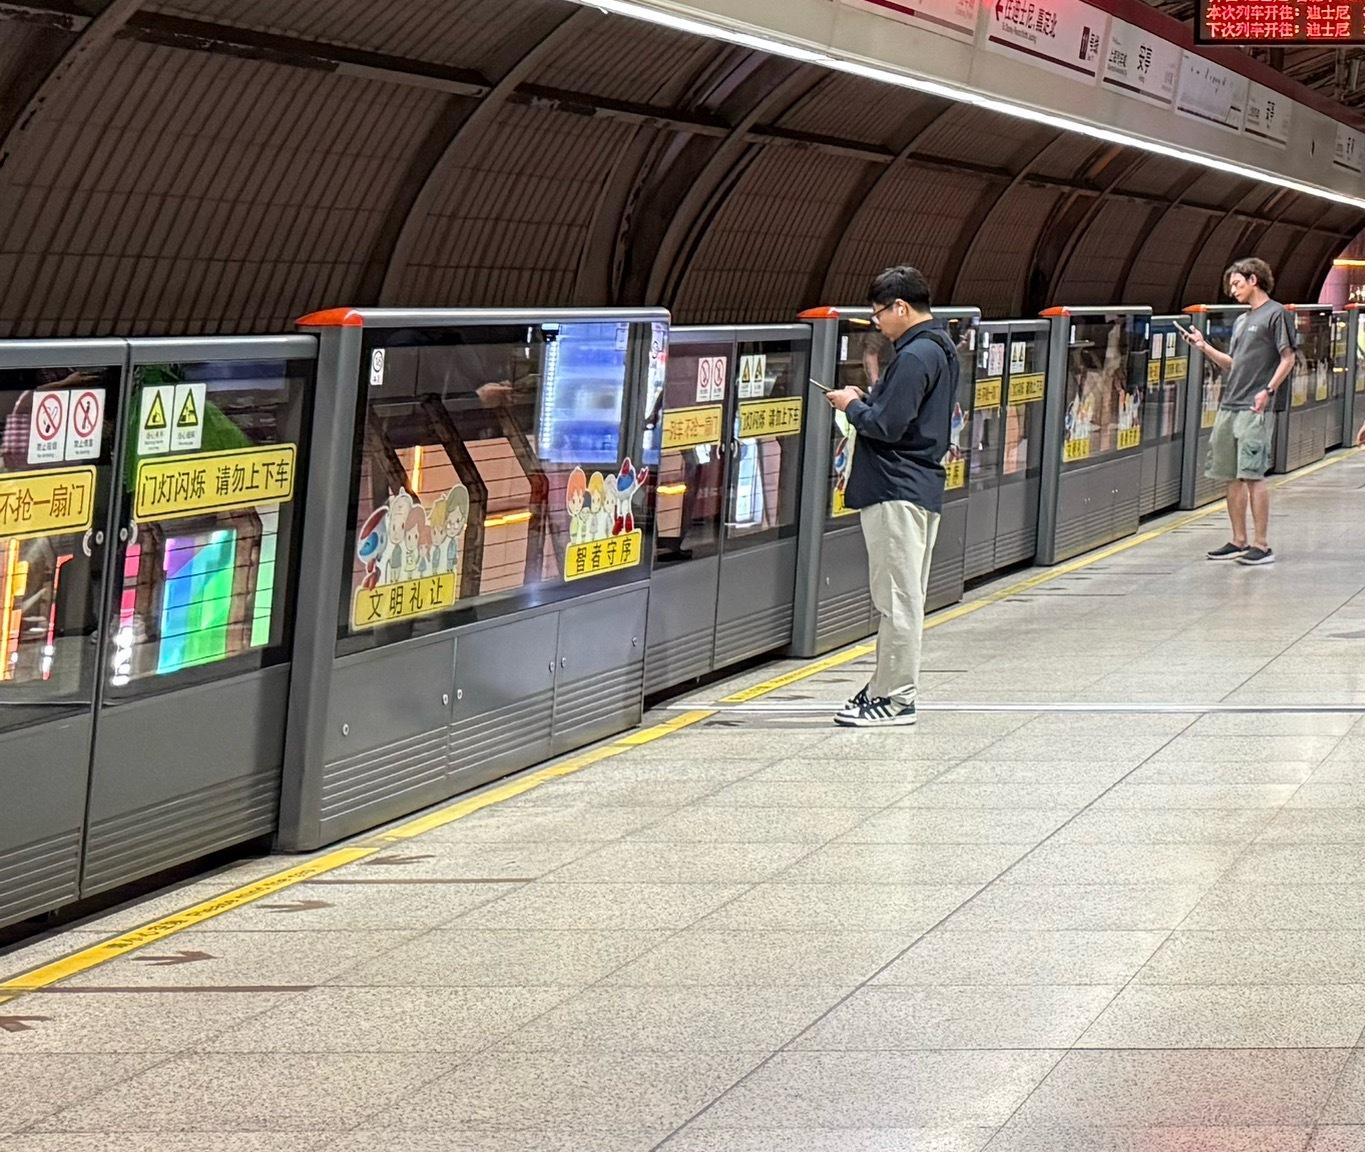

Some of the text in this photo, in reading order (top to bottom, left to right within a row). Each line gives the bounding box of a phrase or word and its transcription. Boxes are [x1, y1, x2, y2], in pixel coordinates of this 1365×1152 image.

[1306, 5, 1351, 20] 迪士尼
[1306, 22, 1351, 38] 迪士尼
[141, 458, 290, 508] 门灯闪烁 请勿上下车
[367, 579, 443, 620] 文明礼让
